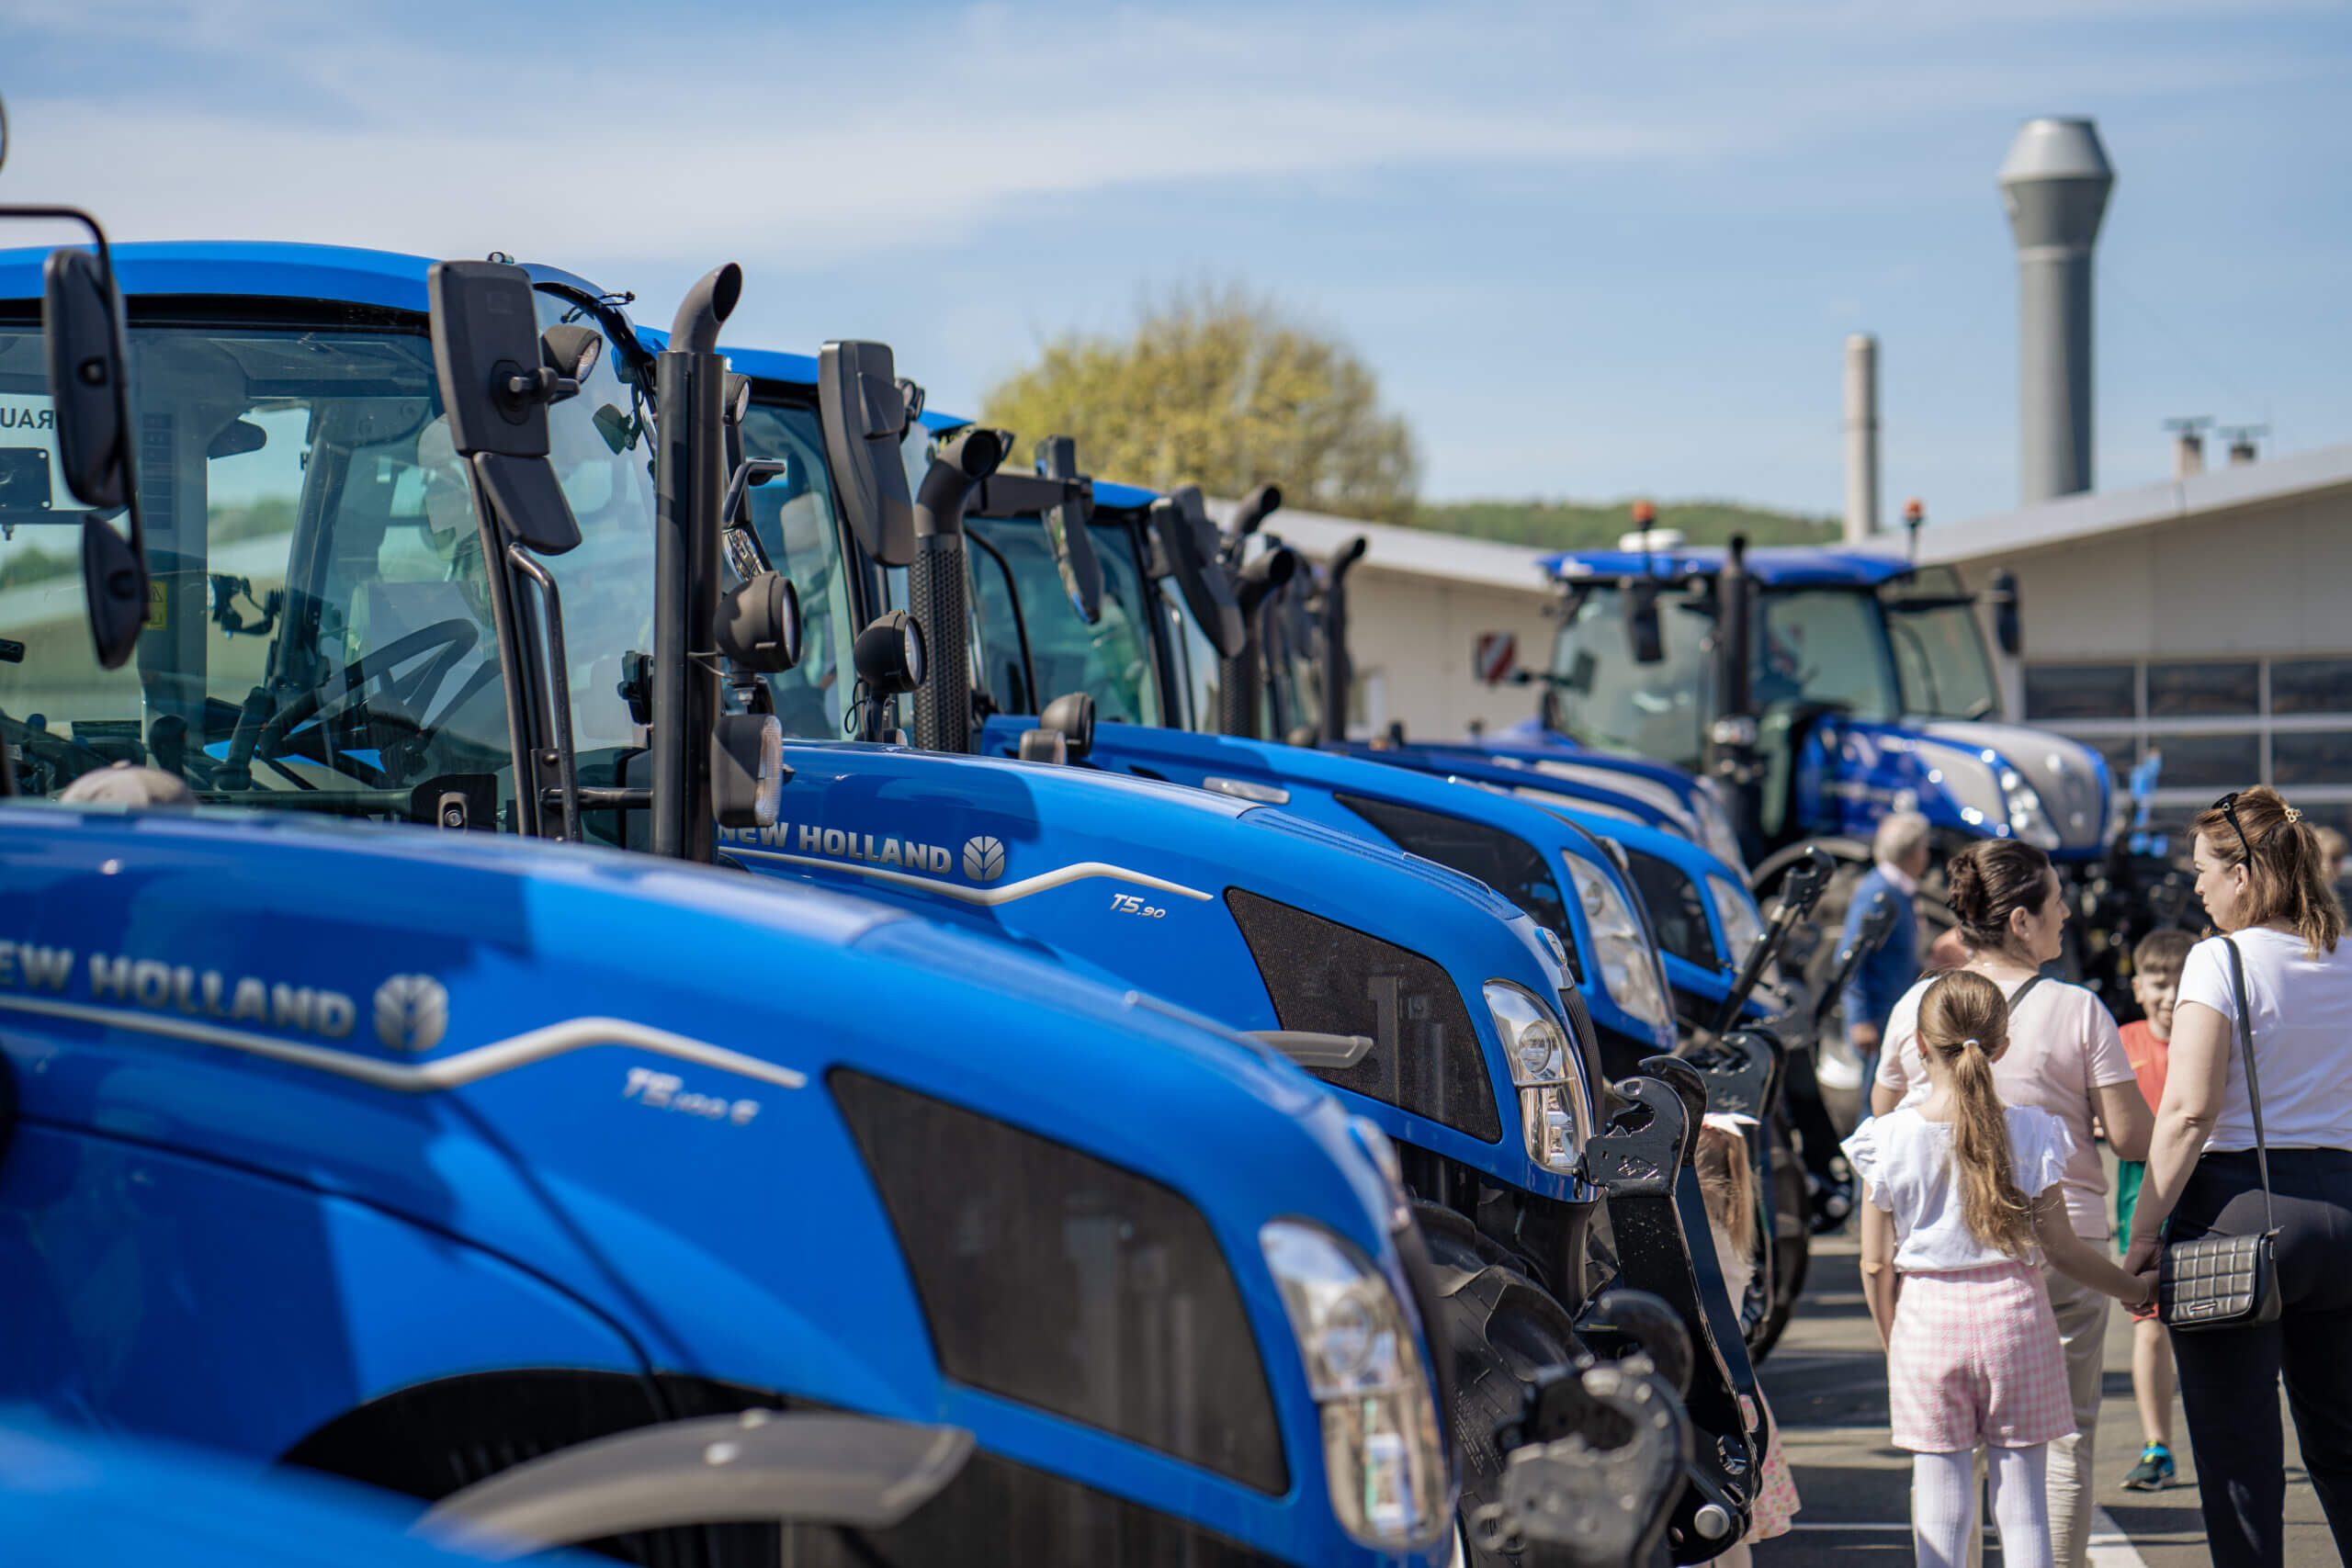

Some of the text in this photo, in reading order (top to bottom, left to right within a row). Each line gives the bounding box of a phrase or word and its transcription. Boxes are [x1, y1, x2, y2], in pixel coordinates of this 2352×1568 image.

[798, 824, 953, 874] HOLLAND
[1109, 893, 1167, 919] T5.90
[0, 940, 356, 1039] EW HOLLAND
